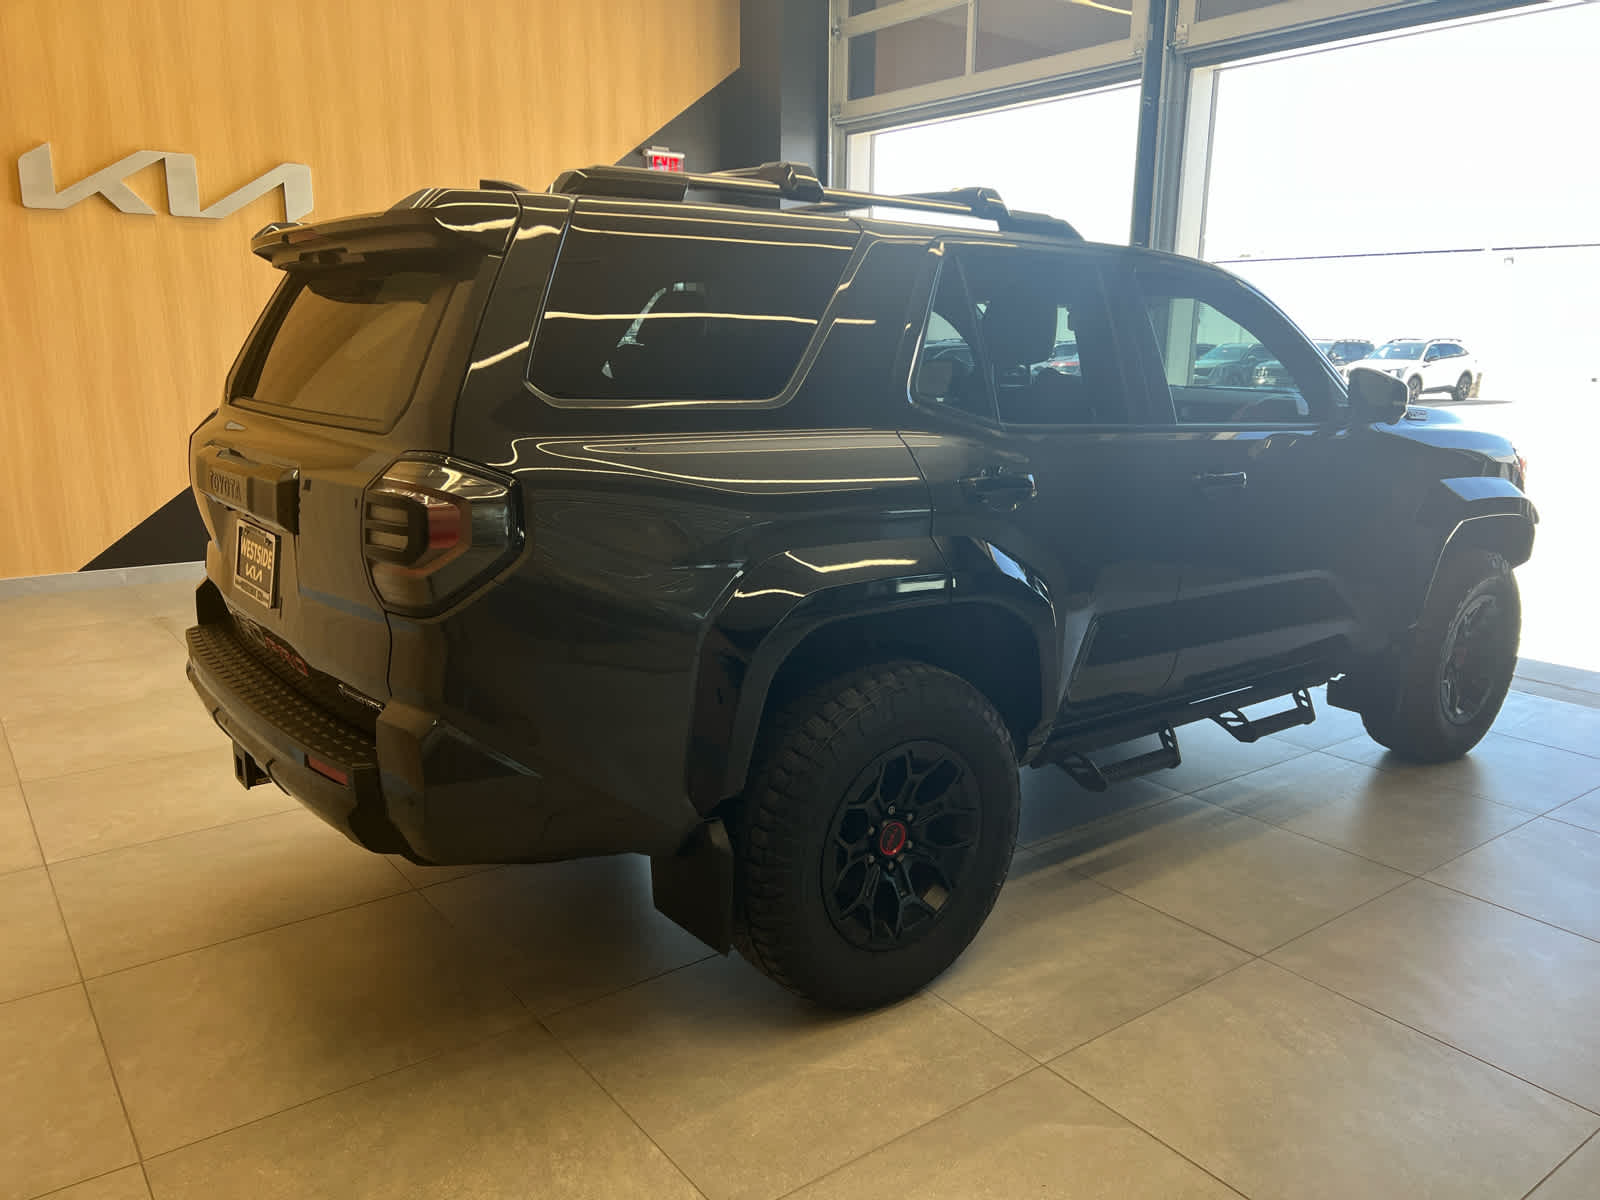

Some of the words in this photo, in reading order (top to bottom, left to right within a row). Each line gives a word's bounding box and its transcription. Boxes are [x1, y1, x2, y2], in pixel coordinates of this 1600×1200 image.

[653, 155, 680, 172] EXIT
[209, 470, 242, 502] TOYOTA
[241, 536, 273, 570] WESTSIDE
